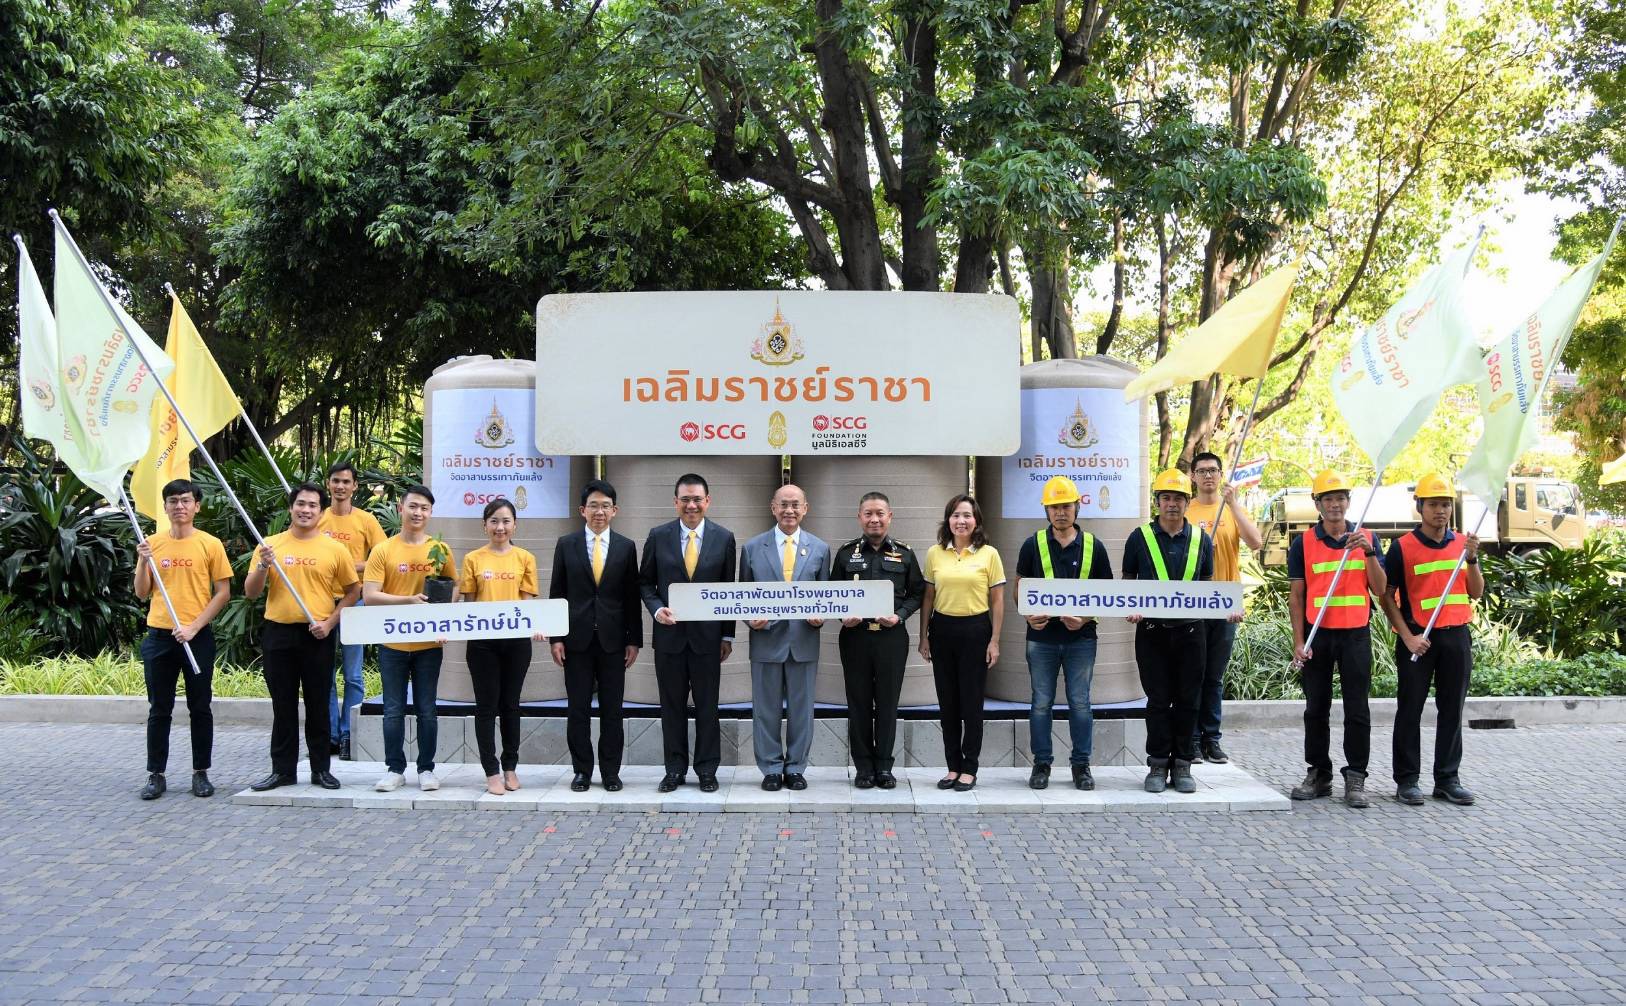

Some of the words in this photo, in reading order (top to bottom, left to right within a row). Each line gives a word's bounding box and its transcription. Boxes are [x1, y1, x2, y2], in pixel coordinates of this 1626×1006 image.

[623, 366, 932, 403] เฉลิมราชย์ราชา
[832, 416, 867, 430] SCG
[704, 424, 746, 440] SCG
[811, 440, 868, 450] มูลนิธิเอสซีจี
[442, 453, 554, 468] เฉลิมราชย์ราชา
[1018, 453, 1129, 468] เฉลิมราชย์ราชา
[450, 472, 543, 482] จิตอาสาบรรเทาภัยแล้ง
[332, 532, 351, 541] SCG
[172, 558, 193, 567] SCG
[295, 557, 317, 566] SCG
[409, 563, 431, 572] SCG
[494, 572, 515, 580] SCG
[700, 586, 865, 600] จิตอาสาพัฒนาโรงพยาบาล
[1027, 590, 1234, 609] จิตอาสาบรรเทาภัยแล้ง
[713, 600, 849, 617] สมเด็จพระยุพราชทั่วไทย
[383, 607, 532, 635] จิตอาสารักษ์น้ำ
